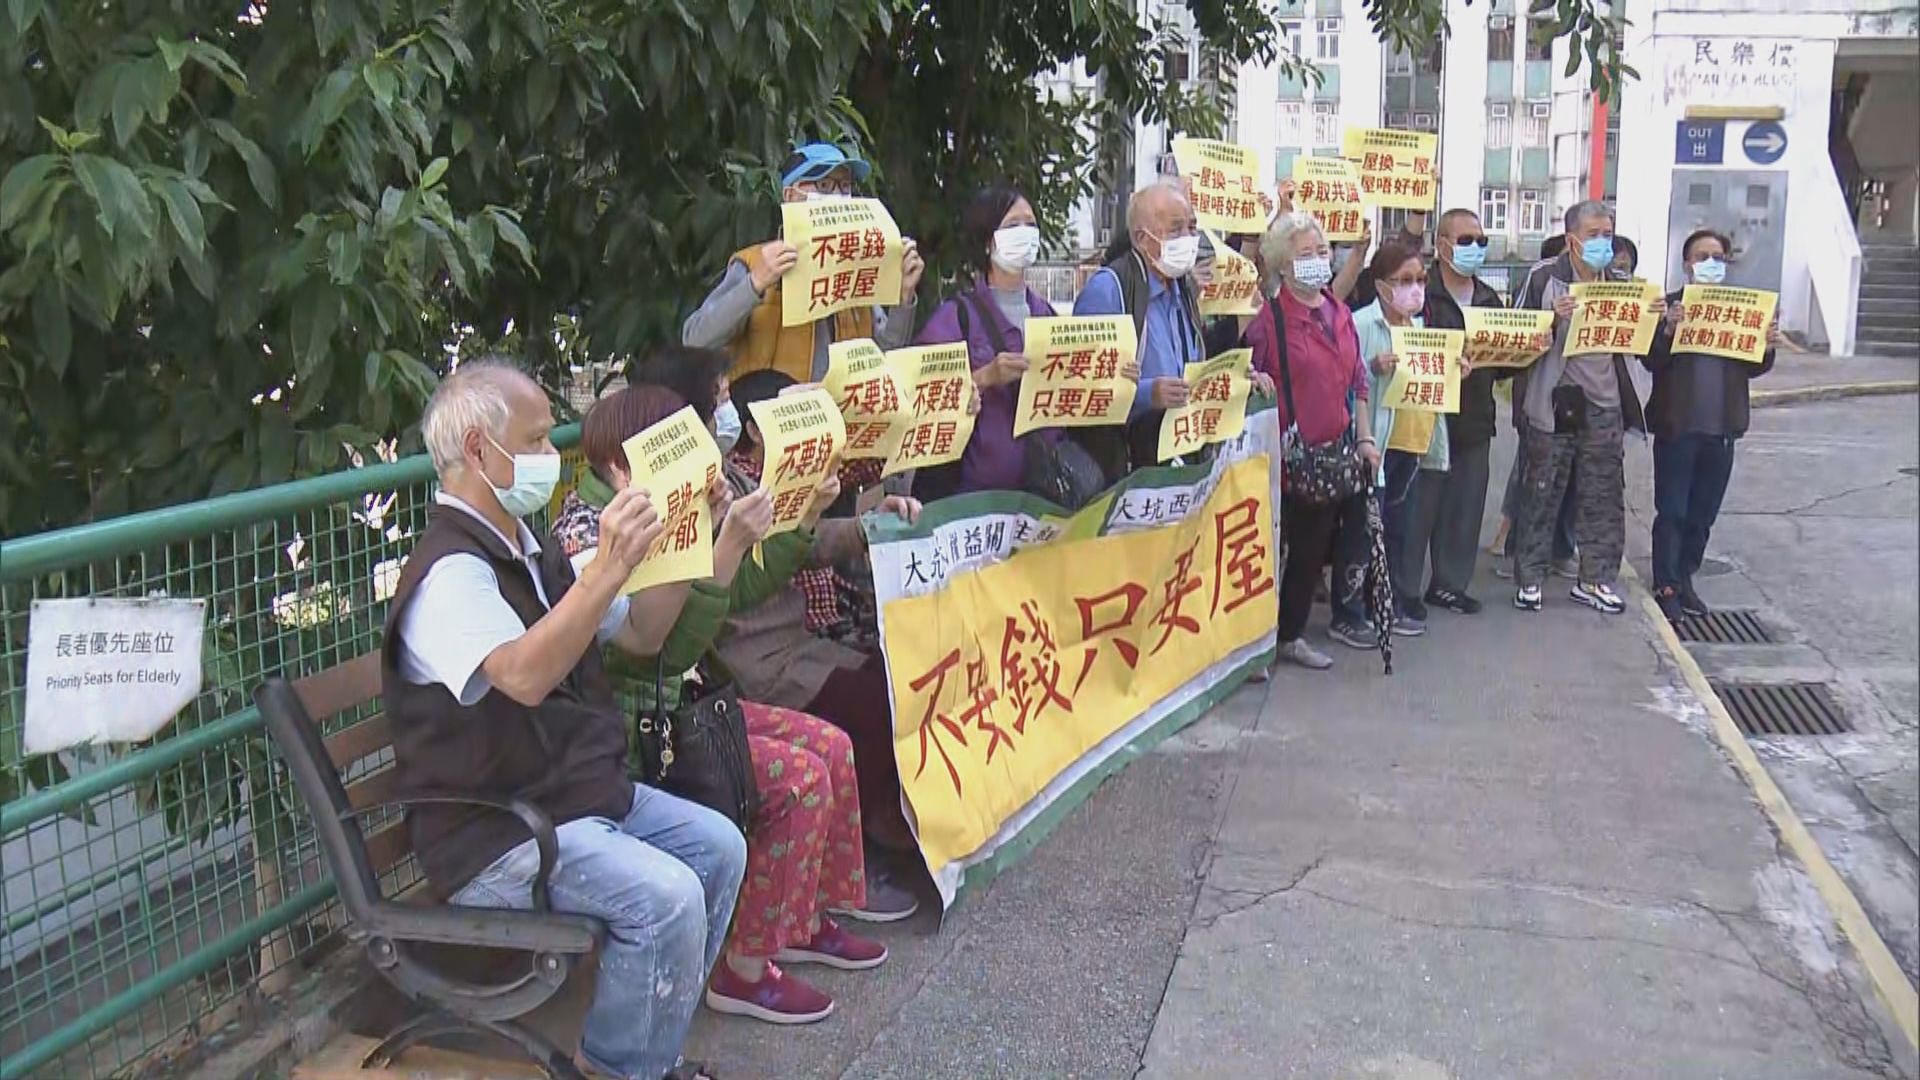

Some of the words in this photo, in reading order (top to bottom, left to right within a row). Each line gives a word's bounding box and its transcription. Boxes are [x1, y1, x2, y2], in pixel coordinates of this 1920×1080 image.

[1688, 127, 1712, 138] OUT
[1693, 141, 1707, 158] 出
[1299, 180, 1360, 204] 爭取共識
[811, 228, 886, 269] 不要錢
[808, 266, 879, 312] 只要屋
[1584, 299, 1640, 323] 不要錢
[1687, 303, 1765, 330] 爭取共識
[1575, 326, 1635, 349] 只要屋
[1679, 326, 1758, 354] 啟動重建
[1040, 348, 1119, 382] 不要錢
[1405, 352, 1446, 376] 不要錢
[839, 373, 900, 417] 不要錢
[912, 375, 964, 418] 不要錢
[1029, 387, 1114, 421] 只要屋
[1400, 382, 1446, 406] 只要屋
[896, 421, 957, 463] 只要屋
[775, 431, 833, 485] 不要錢
[56, 631, 175, 658] 長者優先座位
[46, 673, 83, 691] Priority
[83, 671, 113, 686] Seats
[116, 669, 135, 684] for
[137, 669, 181, 686] Elderly
